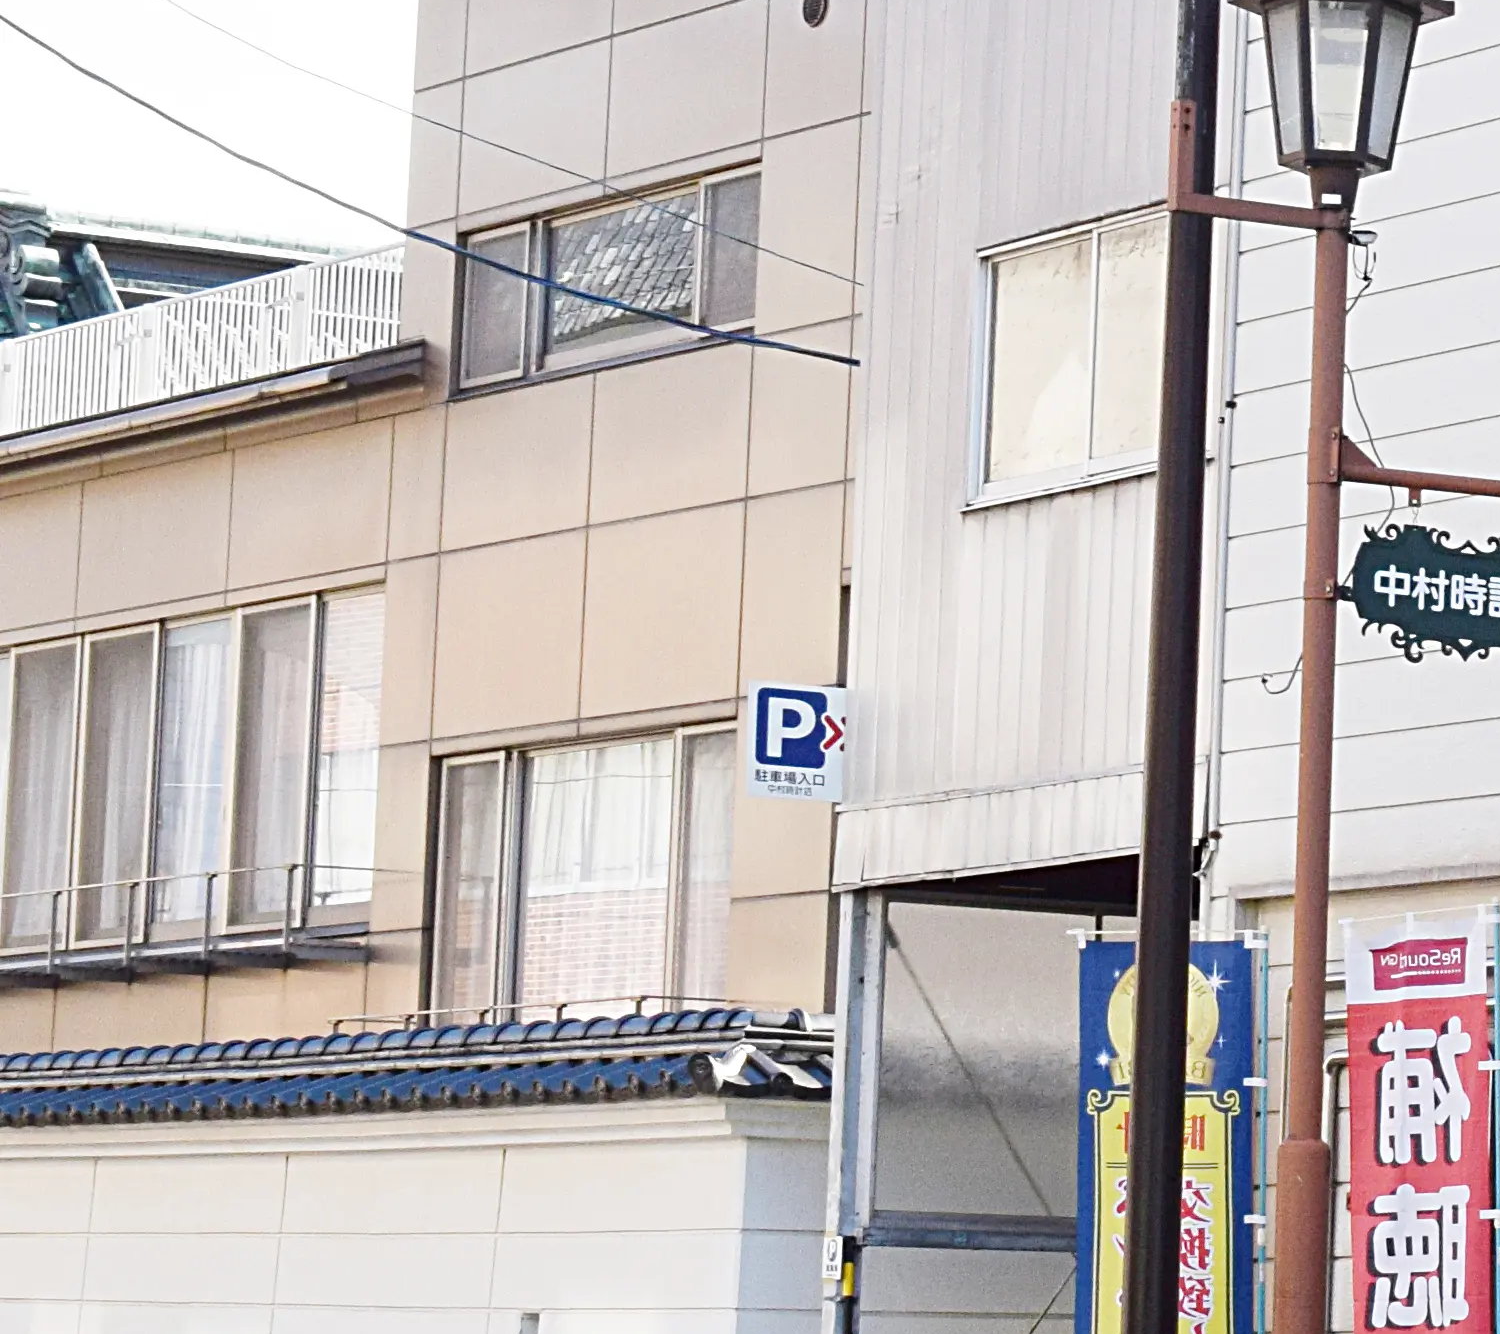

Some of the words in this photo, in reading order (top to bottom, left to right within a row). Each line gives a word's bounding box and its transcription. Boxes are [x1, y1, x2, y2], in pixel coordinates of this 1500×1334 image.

[766, 696, 816, 758] P
[755, 769, 825, 786] 駐車場入口
